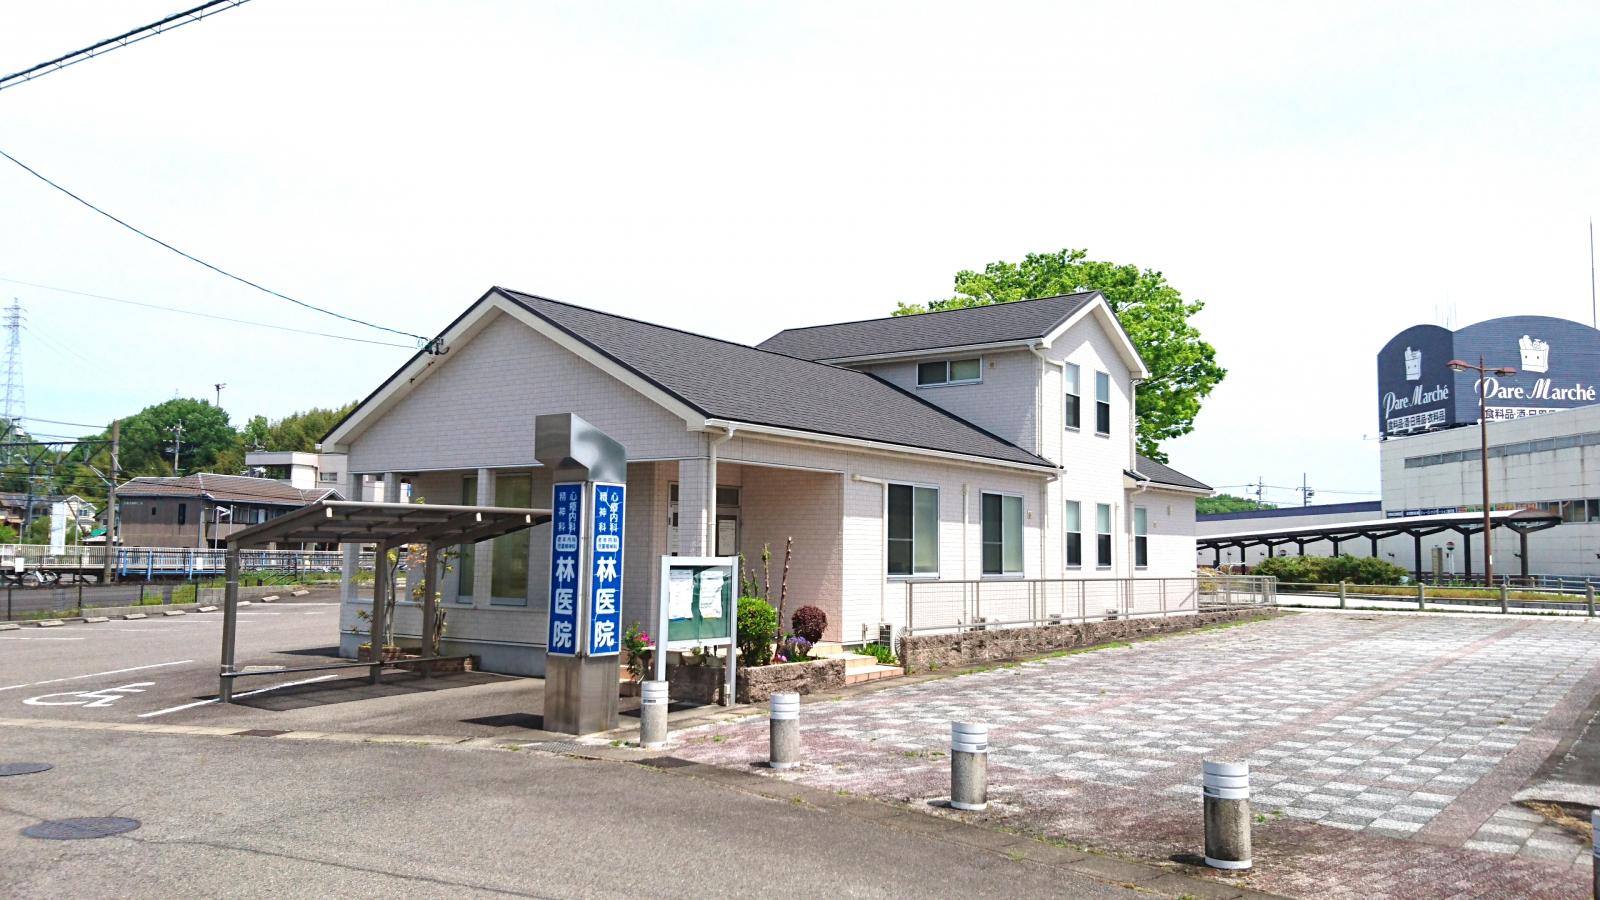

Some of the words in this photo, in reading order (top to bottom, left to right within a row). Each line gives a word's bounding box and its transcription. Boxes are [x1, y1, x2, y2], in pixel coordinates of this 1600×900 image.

[1383, 392, 1409, 419] Pare
[1409, 385, 1449, 406] Marché
[1474, 376, 1524, 406] Pare
[1526, 378, 1596, 401] Marché
[558, 491, 567, 532] 精神科
[568, 491, 577, 532] 心療内科
[598, 491, 608, 532] 精神科
[609, 492, 619, 532] 心療内科
[552, 556, 575, 648] 林医院
[594, 556, 617, 648] 林医院
